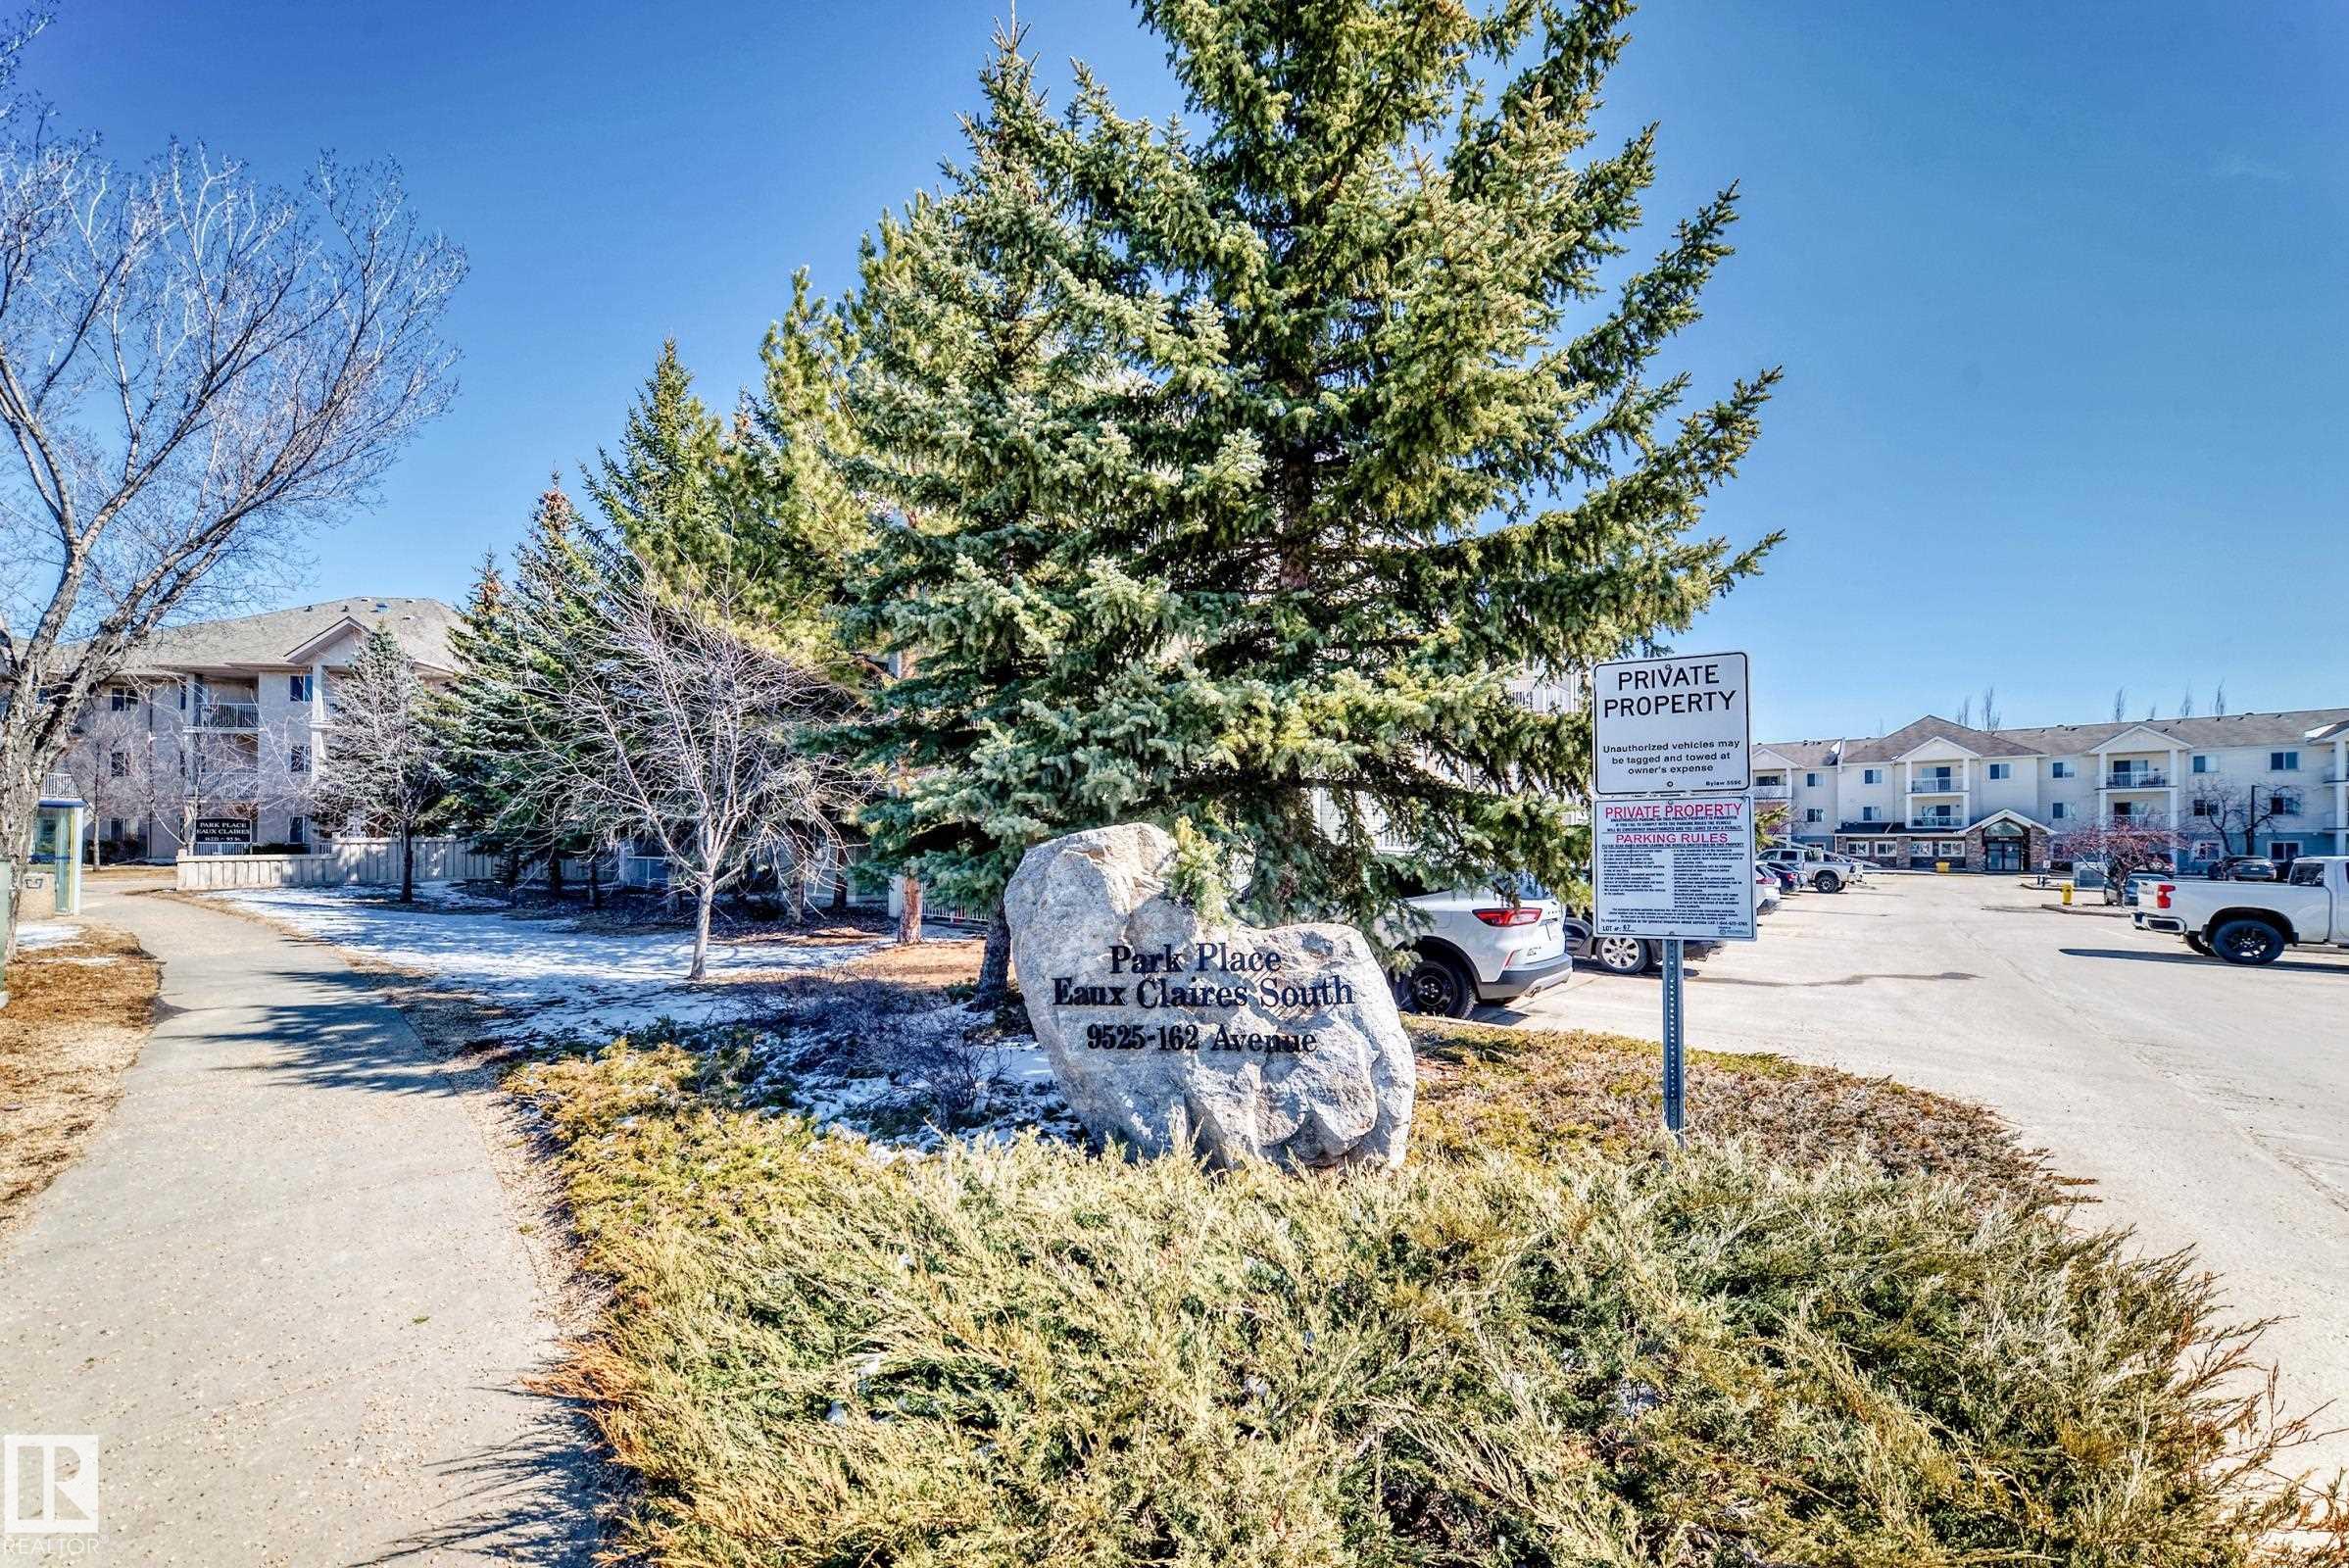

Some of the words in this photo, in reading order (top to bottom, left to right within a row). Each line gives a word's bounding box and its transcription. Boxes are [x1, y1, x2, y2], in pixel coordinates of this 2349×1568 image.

[1618, 664, 1719, 691] PRIVATE
[1604, 690, 1737, 718] PROPERTY
[1603, 743, 1668, 754] Unauthorized
[1672, 741, 1715, 751] vehicles
[1718, 740, 1740, 750] may
[1627, 755, 1661, 765] tagged
[1664, 754, 1683, 762] and
[1686, 753, 1717, 761] towed
[1720, 752, 1731, 760] at
[1670, 764, 1714, 774] expense
[1605, 806, 1661, 819] PRIVATE
[1666, 803, 1742, 817] PROPERTY
[1617, 834, 1677, 843] PARKING
[1682, 833, 1729, 843] RULES
[1108, 944, 1183, 974] Park
[1196, 942, 1282, 973] Place
[1051, 977, 1127, 1006] Eaux
[1137, 976, 1248, 1009] Claires
[1260, 974, 1355, 1008] South
[1086, 1023, 1199, 1052] 9525-162
[1210, 1023, 1318, 1054] Avenue
